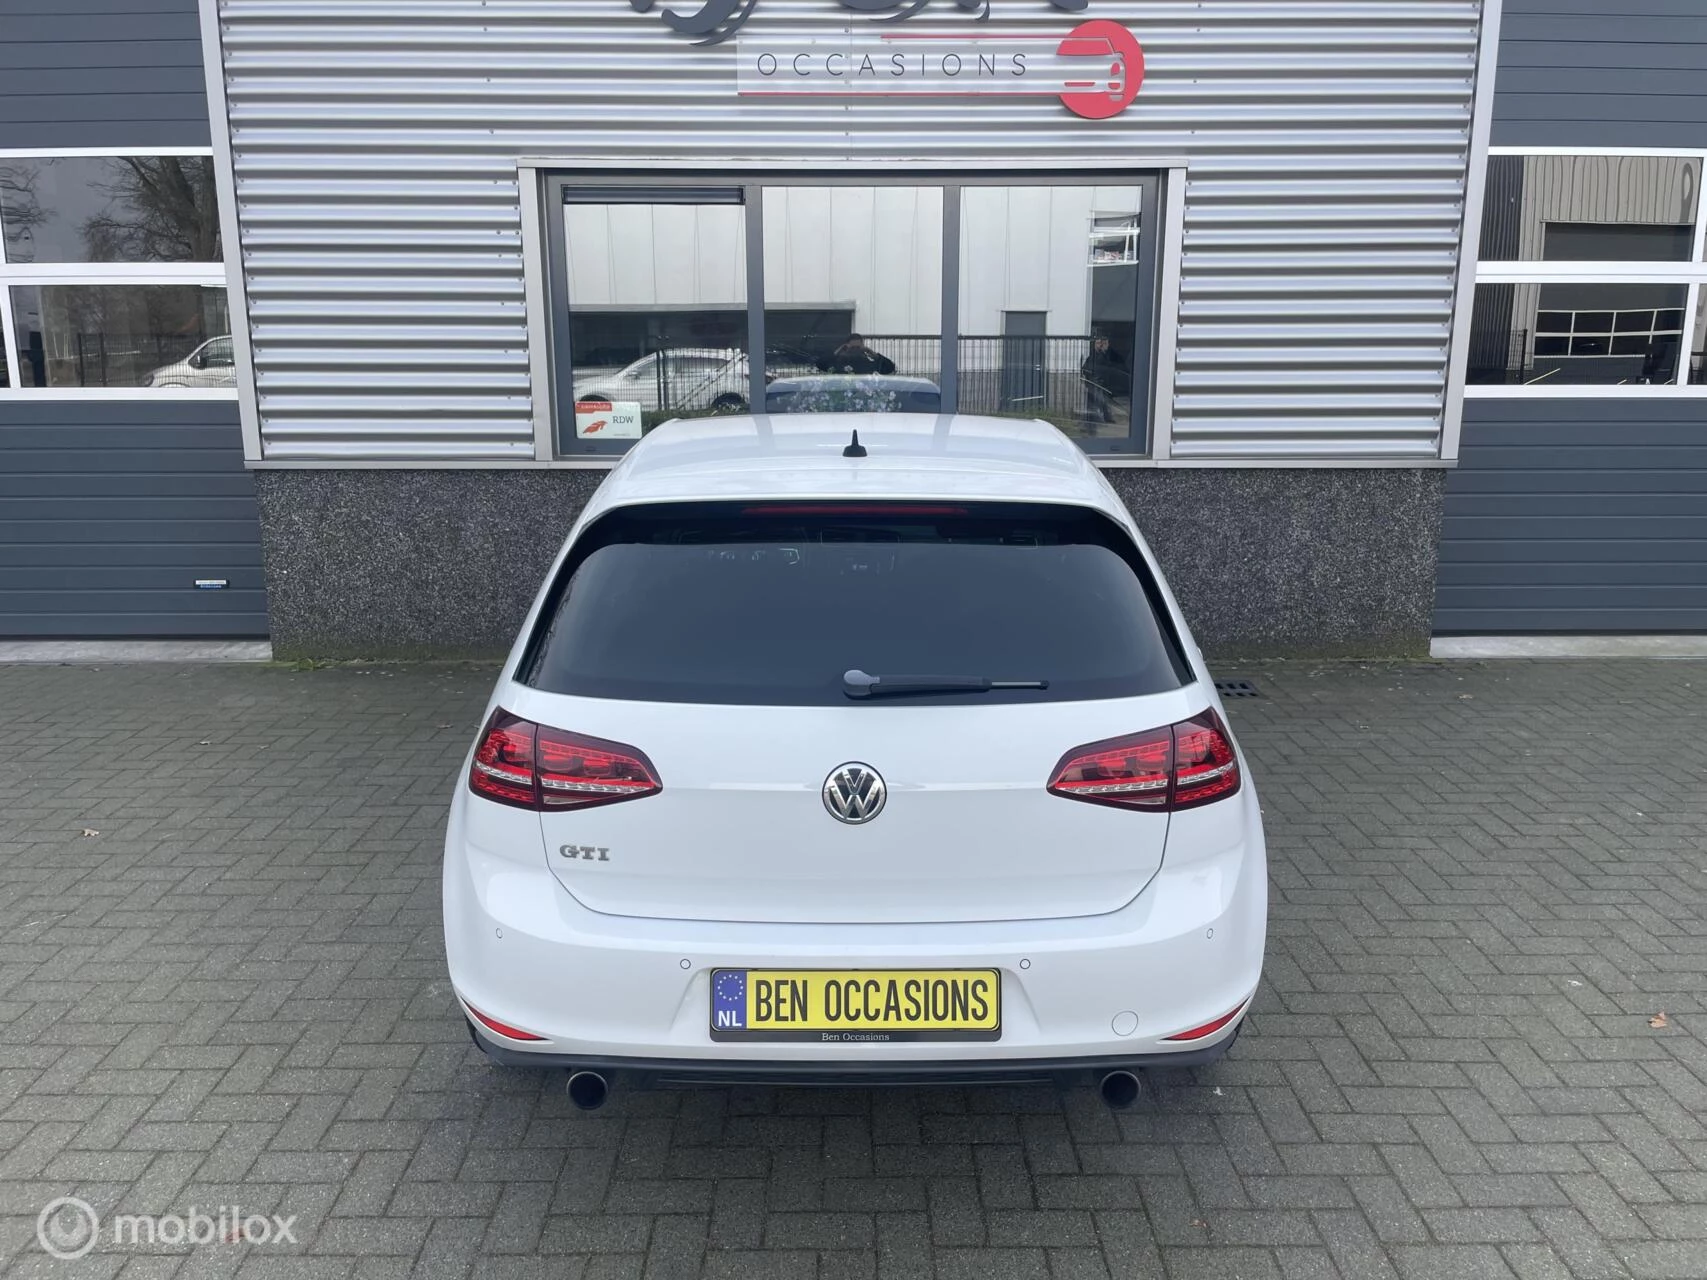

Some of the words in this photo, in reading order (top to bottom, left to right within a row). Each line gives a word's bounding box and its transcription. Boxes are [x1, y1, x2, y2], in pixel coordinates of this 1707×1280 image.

[757, 53, 1027, 76] OCCASIONS
[612, 416, 634, 424] RDW
[560, 845, 610, 861] GTI
[755, 980, 808, 1022] BEN
[825, 979, 989, 1022] OCCASIONS
[718, 1010, 742, 1027] NL
[822, 1032, 840, 1041] Ben
[843, 1032, 890, 1041] Occasions
